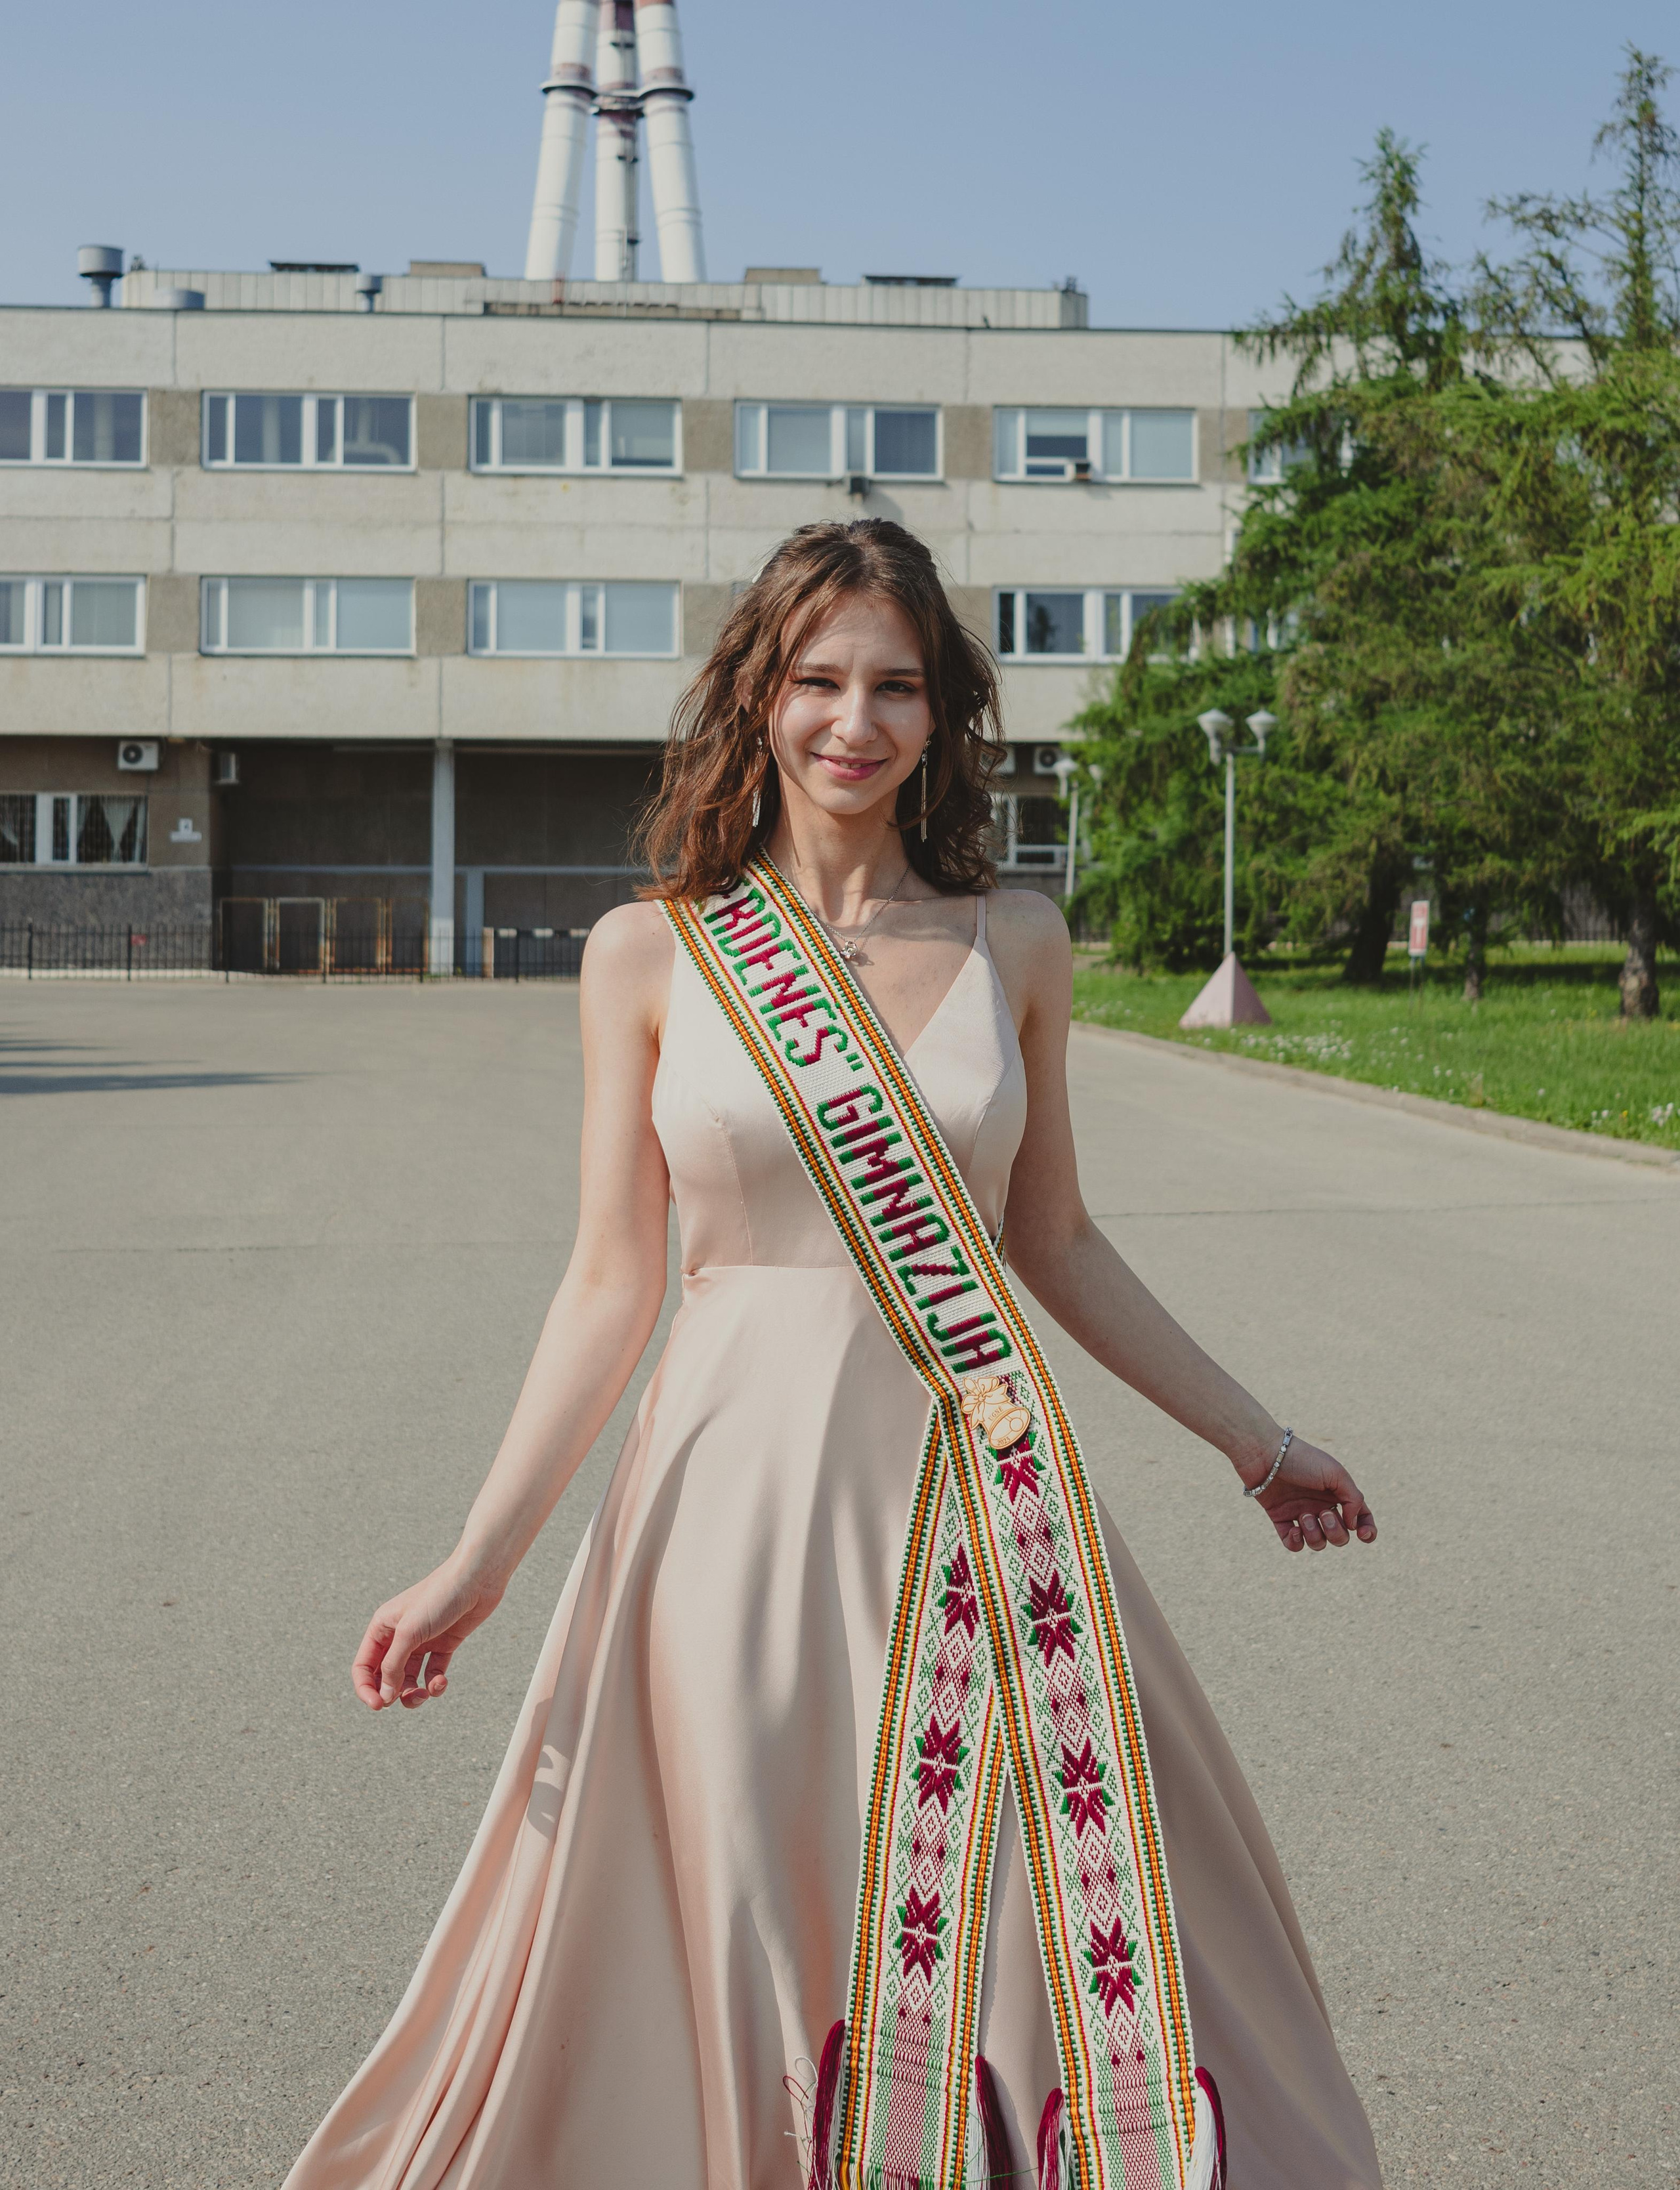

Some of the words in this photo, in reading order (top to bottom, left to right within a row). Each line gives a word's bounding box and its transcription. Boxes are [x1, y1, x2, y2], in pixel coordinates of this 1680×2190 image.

[693, 877, 864, 1072] RDENĖS"
[816, 1084, 1012, 1374] GIMNAZIJA
[997, 1437, 1011, 1446] 2023
